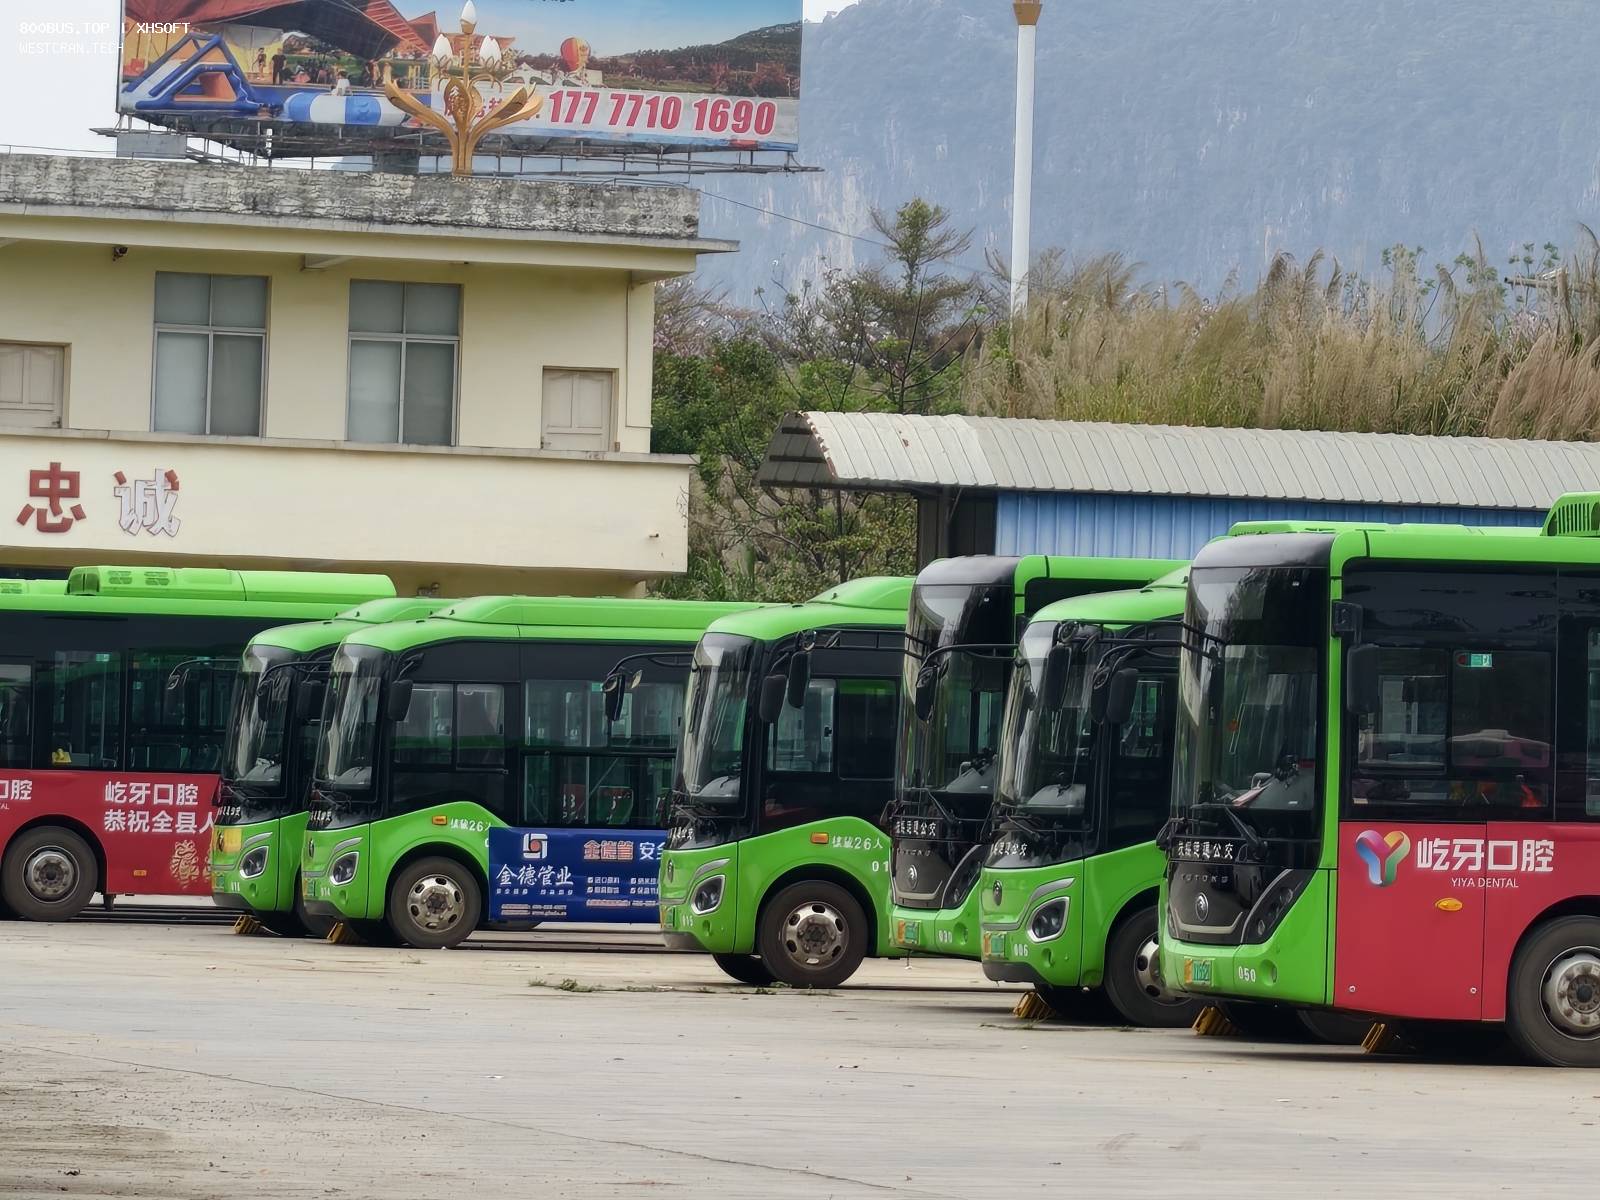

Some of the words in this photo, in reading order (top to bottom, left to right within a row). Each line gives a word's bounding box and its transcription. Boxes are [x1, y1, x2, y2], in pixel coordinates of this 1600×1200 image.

[549, 89, 600, 125] 177
[608, 92, 683, 131] 7710
[693, 97, 777, 136] 1690
[16, 462, 181, 537] 忠诚
[104, 780, 199, 806] 屹牙口腔
[1417, 838, 1555, 873] 屹牙口腔
[496, 863, 574, 887] 金德管业
[1451, 877, 1476, 888] YIYA
[1477, 877, 1519, 889] DENTAL
[1238, 966, 1257, 983] 050
